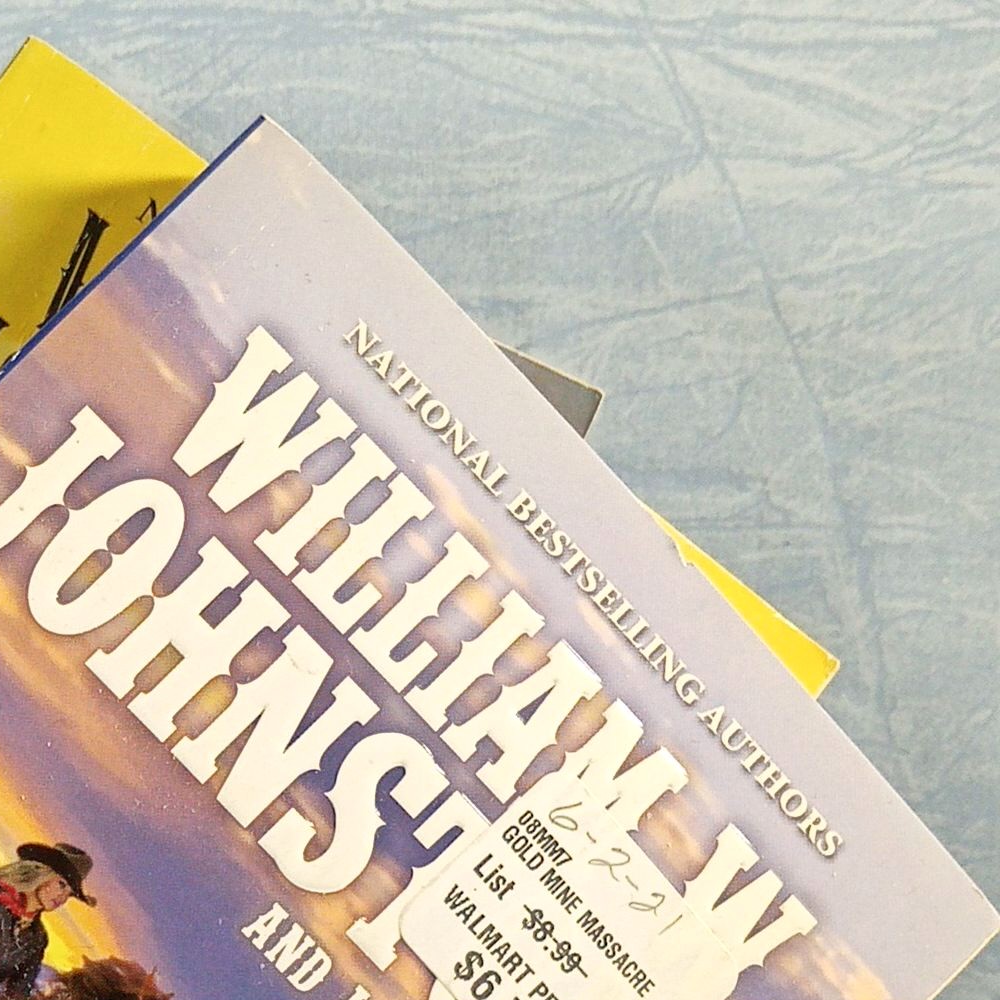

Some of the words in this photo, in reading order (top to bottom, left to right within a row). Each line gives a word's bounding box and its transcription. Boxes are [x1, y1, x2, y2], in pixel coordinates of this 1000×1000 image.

[173, 325, 690, 833] WILLIAM
[343, 318, 508, 496] NATIONAL
[506, 488, 705, 705] BESTSELLING
[697, 705, 844, 857] AUTHORS
[473, 854, 516, 900] List
[518, 810, 572, 867] 08MM7
[241, 902, 332, 992] AND
[443, 884, 535, 984] WALMART
[502, 825, 542, 871] GOLD
[539, 867, 583, 914] MINE
[576, 910, 655, 998] MASSACRE
